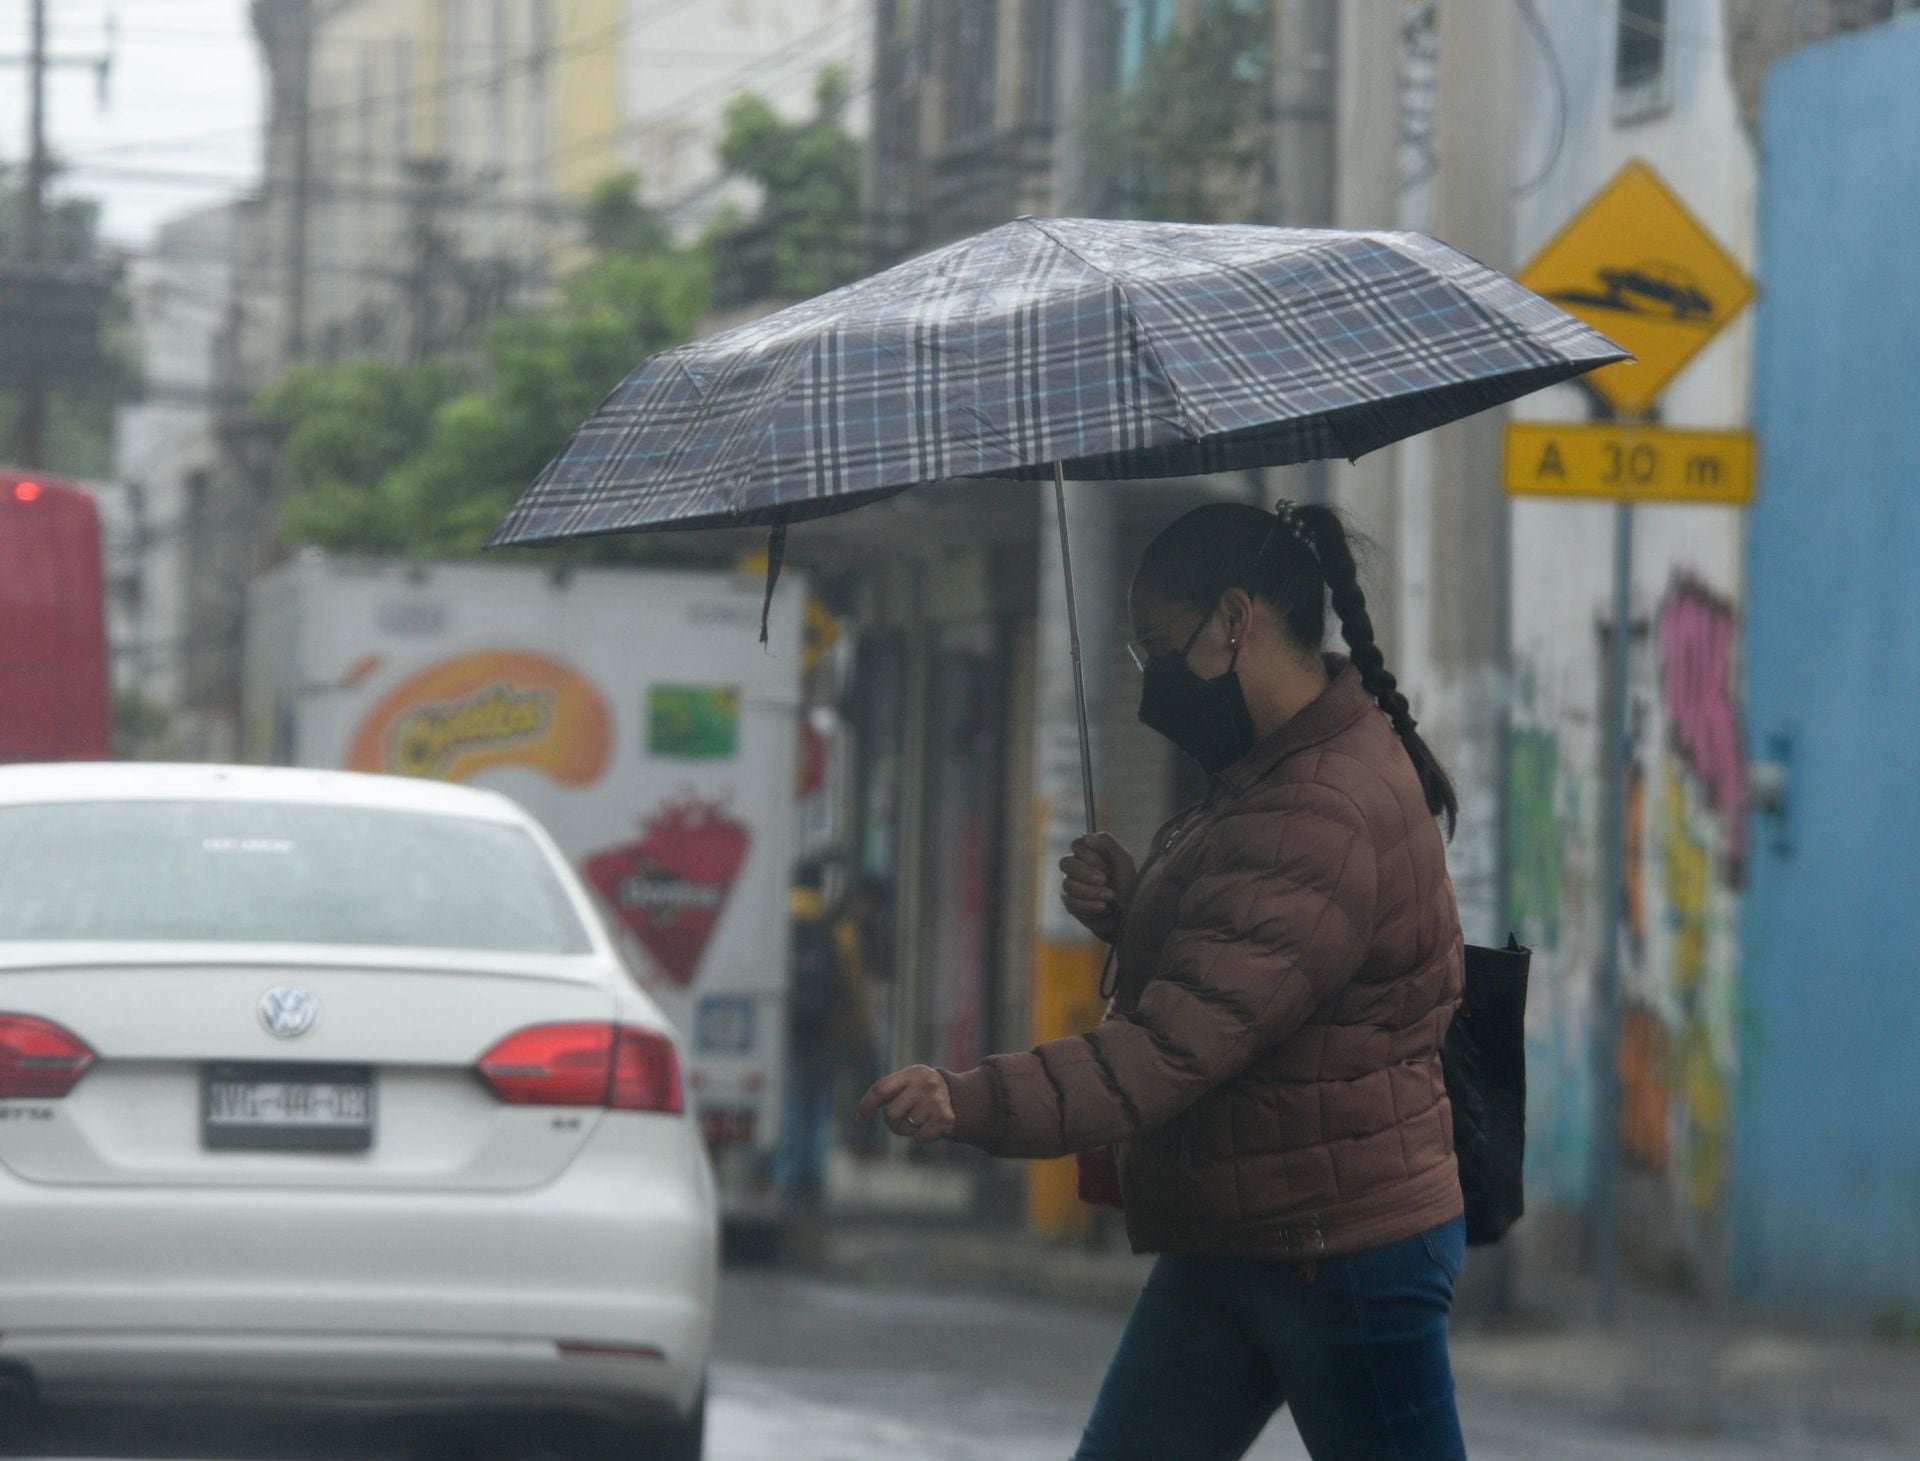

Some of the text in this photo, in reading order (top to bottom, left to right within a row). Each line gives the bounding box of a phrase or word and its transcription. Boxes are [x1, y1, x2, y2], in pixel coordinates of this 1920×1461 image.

[1537, 441, 1722, 487] A 30 m
